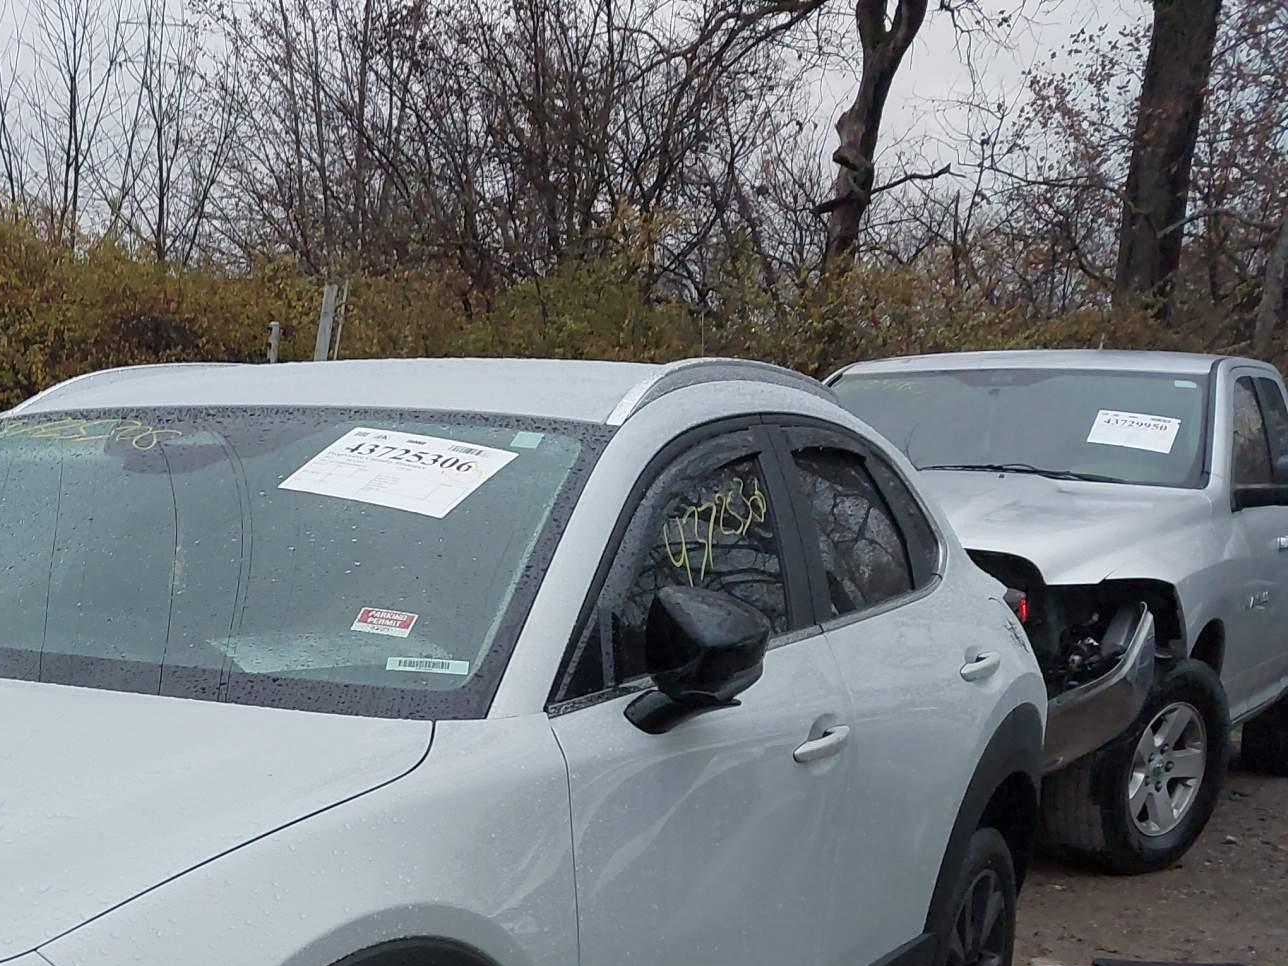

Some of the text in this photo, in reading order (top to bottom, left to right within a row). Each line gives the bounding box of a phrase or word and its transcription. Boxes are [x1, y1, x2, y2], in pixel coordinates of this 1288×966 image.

[346, 442, 473, 472] 43725306
[368, 610, 408, 621] PARKING
[367, 617, 403, 627] PERMIT
